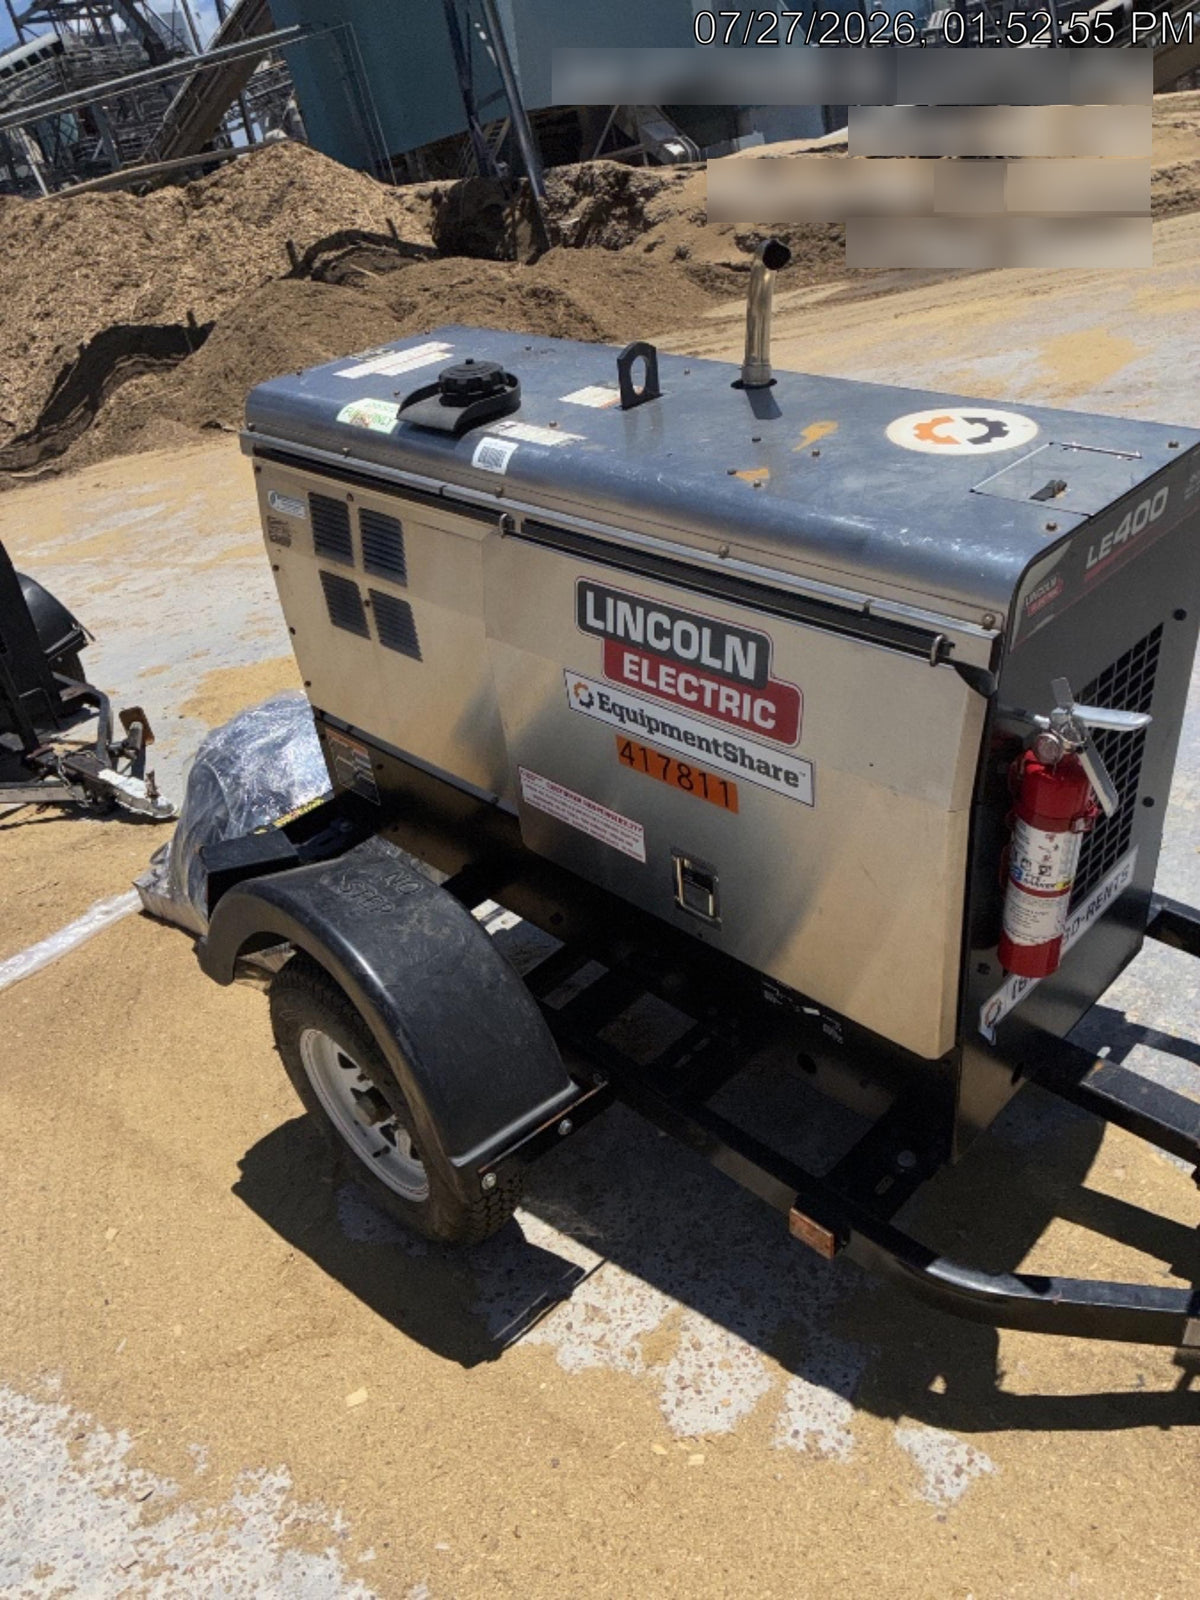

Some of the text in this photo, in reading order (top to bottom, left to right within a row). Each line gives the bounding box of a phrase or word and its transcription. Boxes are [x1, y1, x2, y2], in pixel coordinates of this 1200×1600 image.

[1086, 486, 1169, 569] LE400
[586, 589, 757, 680] LINCOLN
[622, 651, 777, 730] ELECTRIC
[597, 690, 801, 789] EquipmentShare
[620, 739, 730, 808] 417811
